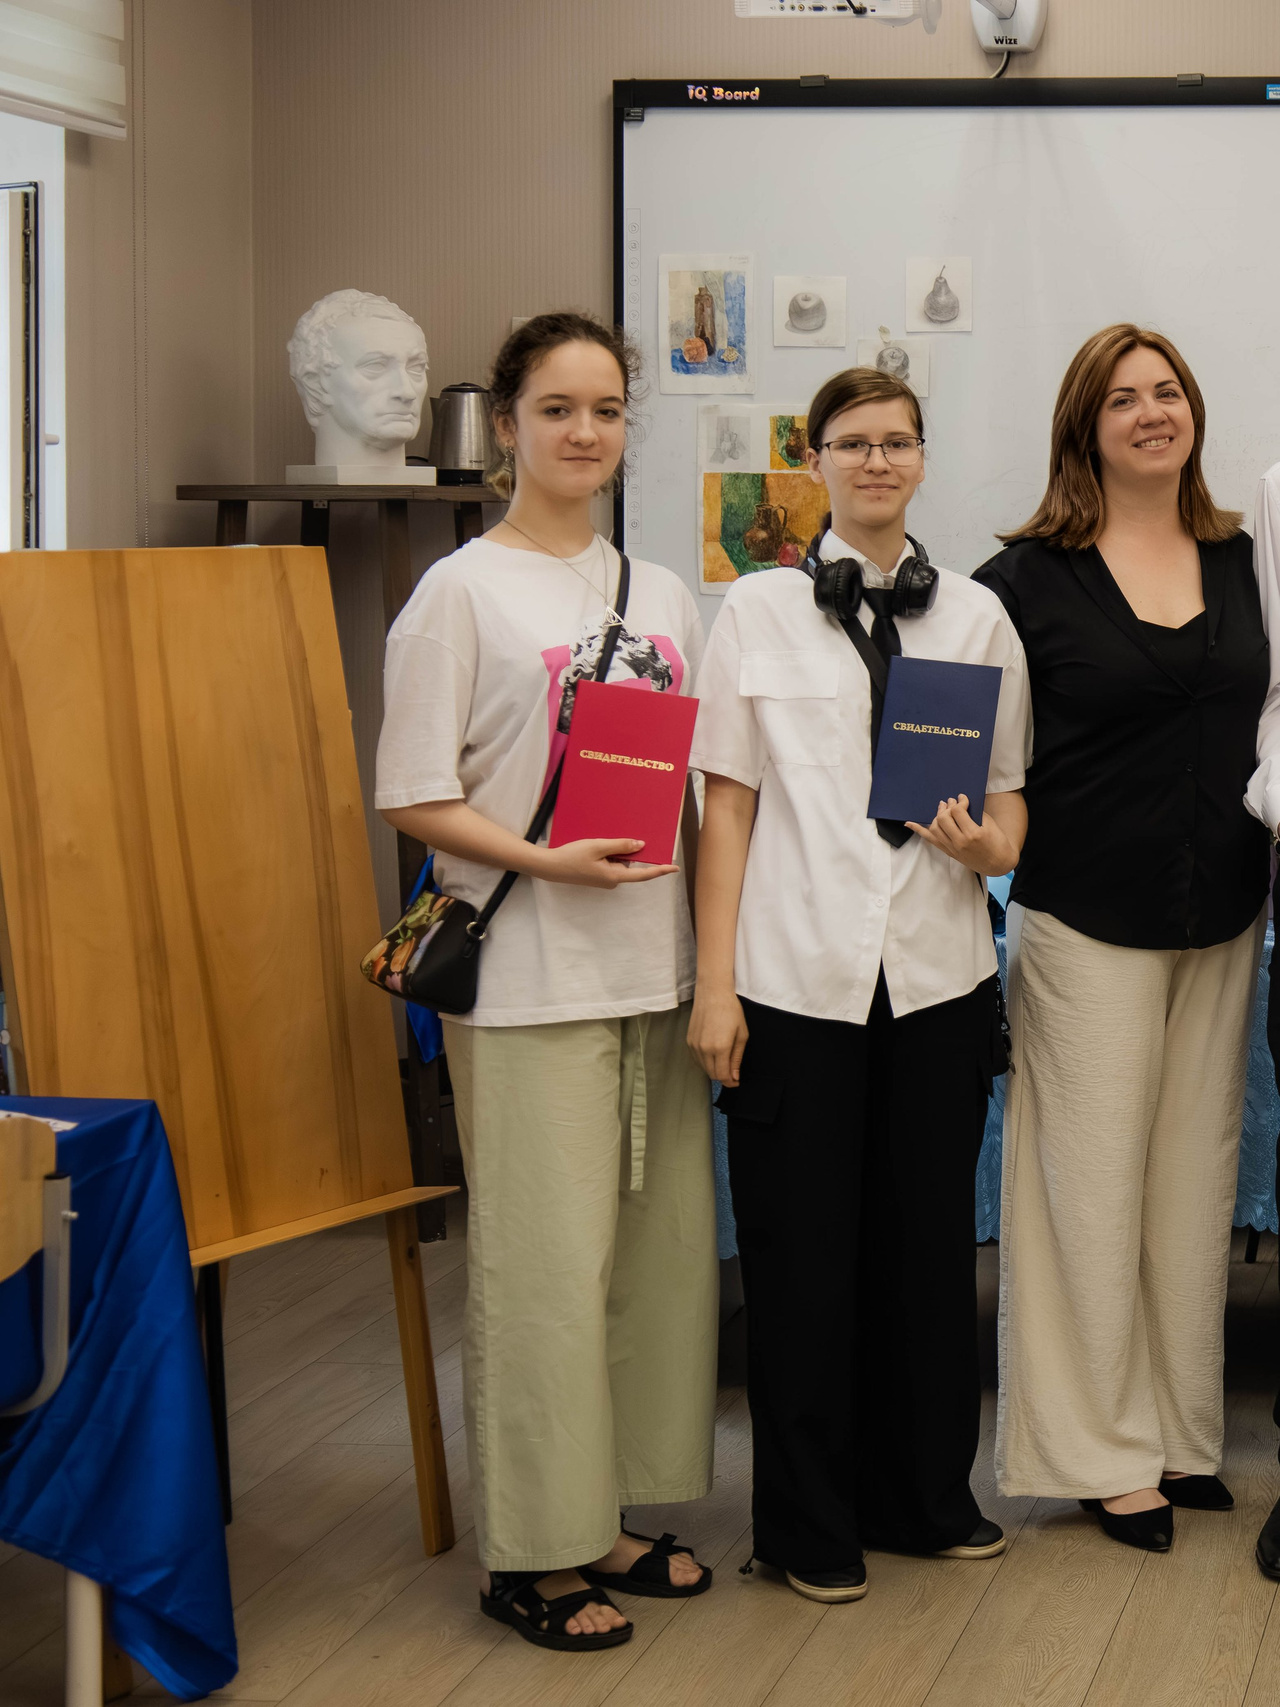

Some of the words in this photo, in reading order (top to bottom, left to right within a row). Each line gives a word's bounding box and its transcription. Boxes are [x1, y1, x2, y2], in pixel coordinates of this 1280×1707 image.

[712, 86, 760, 101] Board
[893, 721, 981, 739] СВИДЕТЕЛЬСТВО
[579, 749, 675, 772] СВИДЕТЕЛЬСТВО
